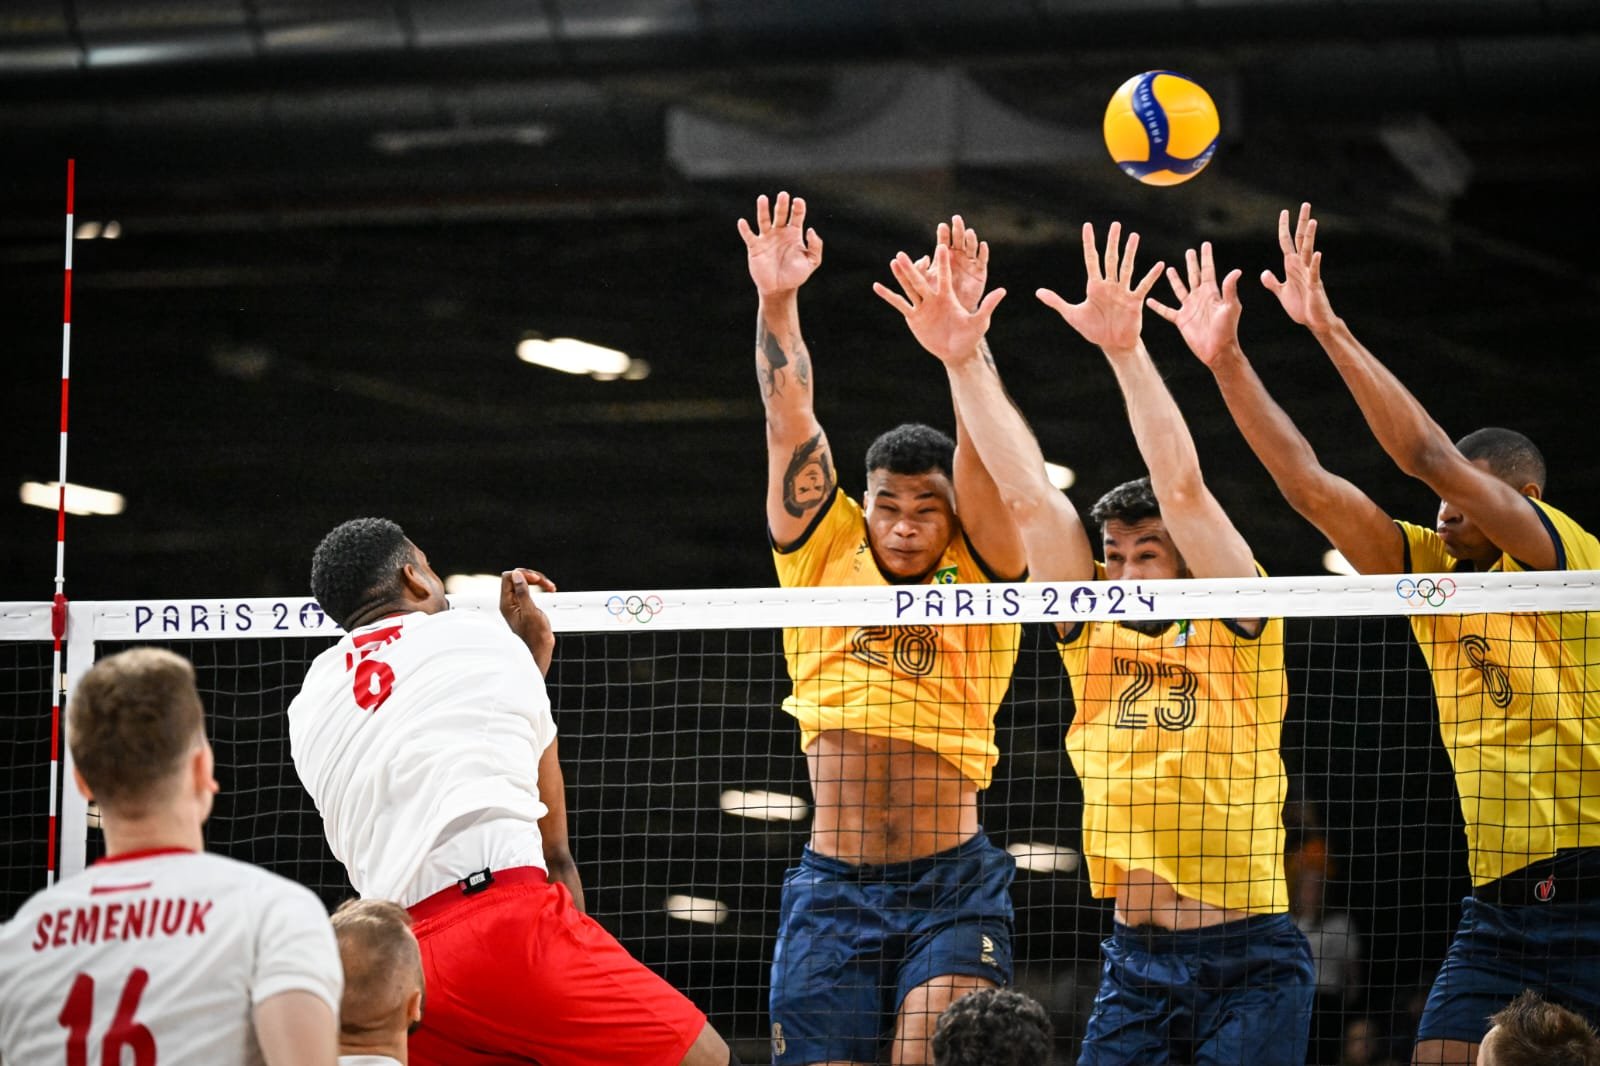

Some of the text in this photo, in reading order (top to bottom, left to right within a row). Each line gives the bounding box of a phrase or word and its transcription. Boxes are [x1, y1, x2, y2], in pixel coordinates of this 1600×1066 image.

[134, 601, 342, 634] PARIS 20
[895, 584, 1156, 618] PARIS 2024
[851, 624, 938, 676] 28
[1460, 634, 1512, 708] 6
[1113, 656, 1199, 732] 23
[32, 897, 214, 952] SEMENIUK
[57, 967, 158, 1066] 16
